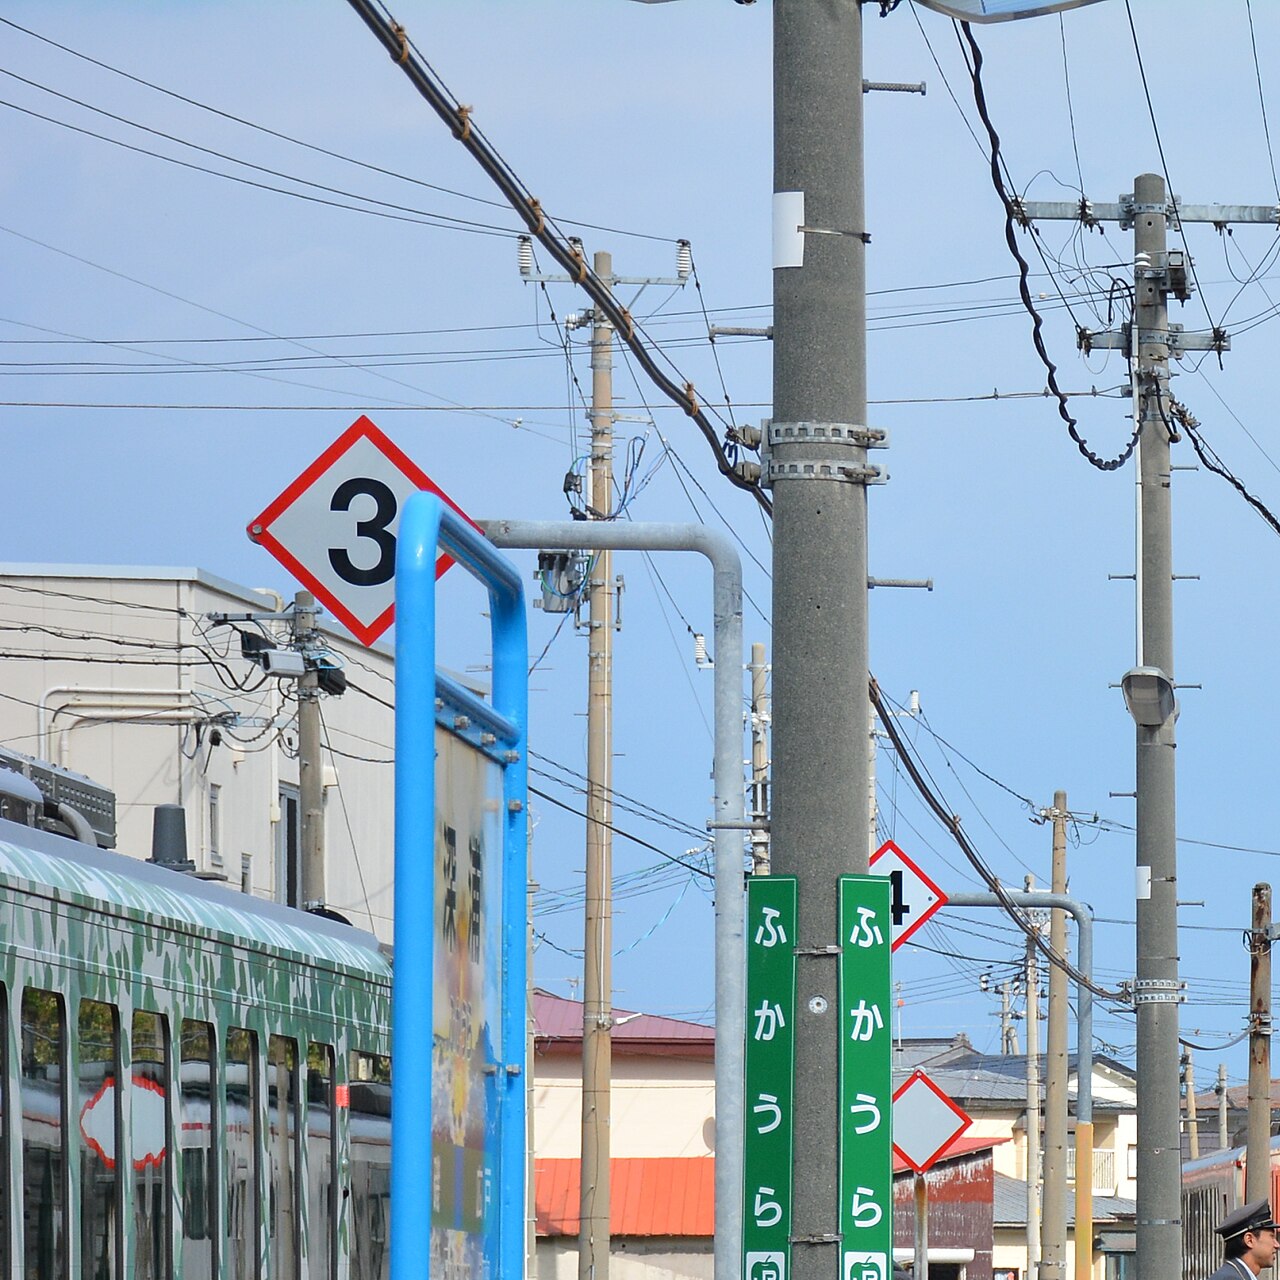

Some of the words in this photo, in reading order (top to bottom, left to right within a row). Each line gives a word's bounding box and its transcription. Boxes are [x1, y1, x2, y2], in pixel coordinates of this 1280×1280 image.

[327, 477, 398, 587] 3
[753, 906, 788, 1228] ふかうら
[849, 906, 884, 1228] ふかうら
